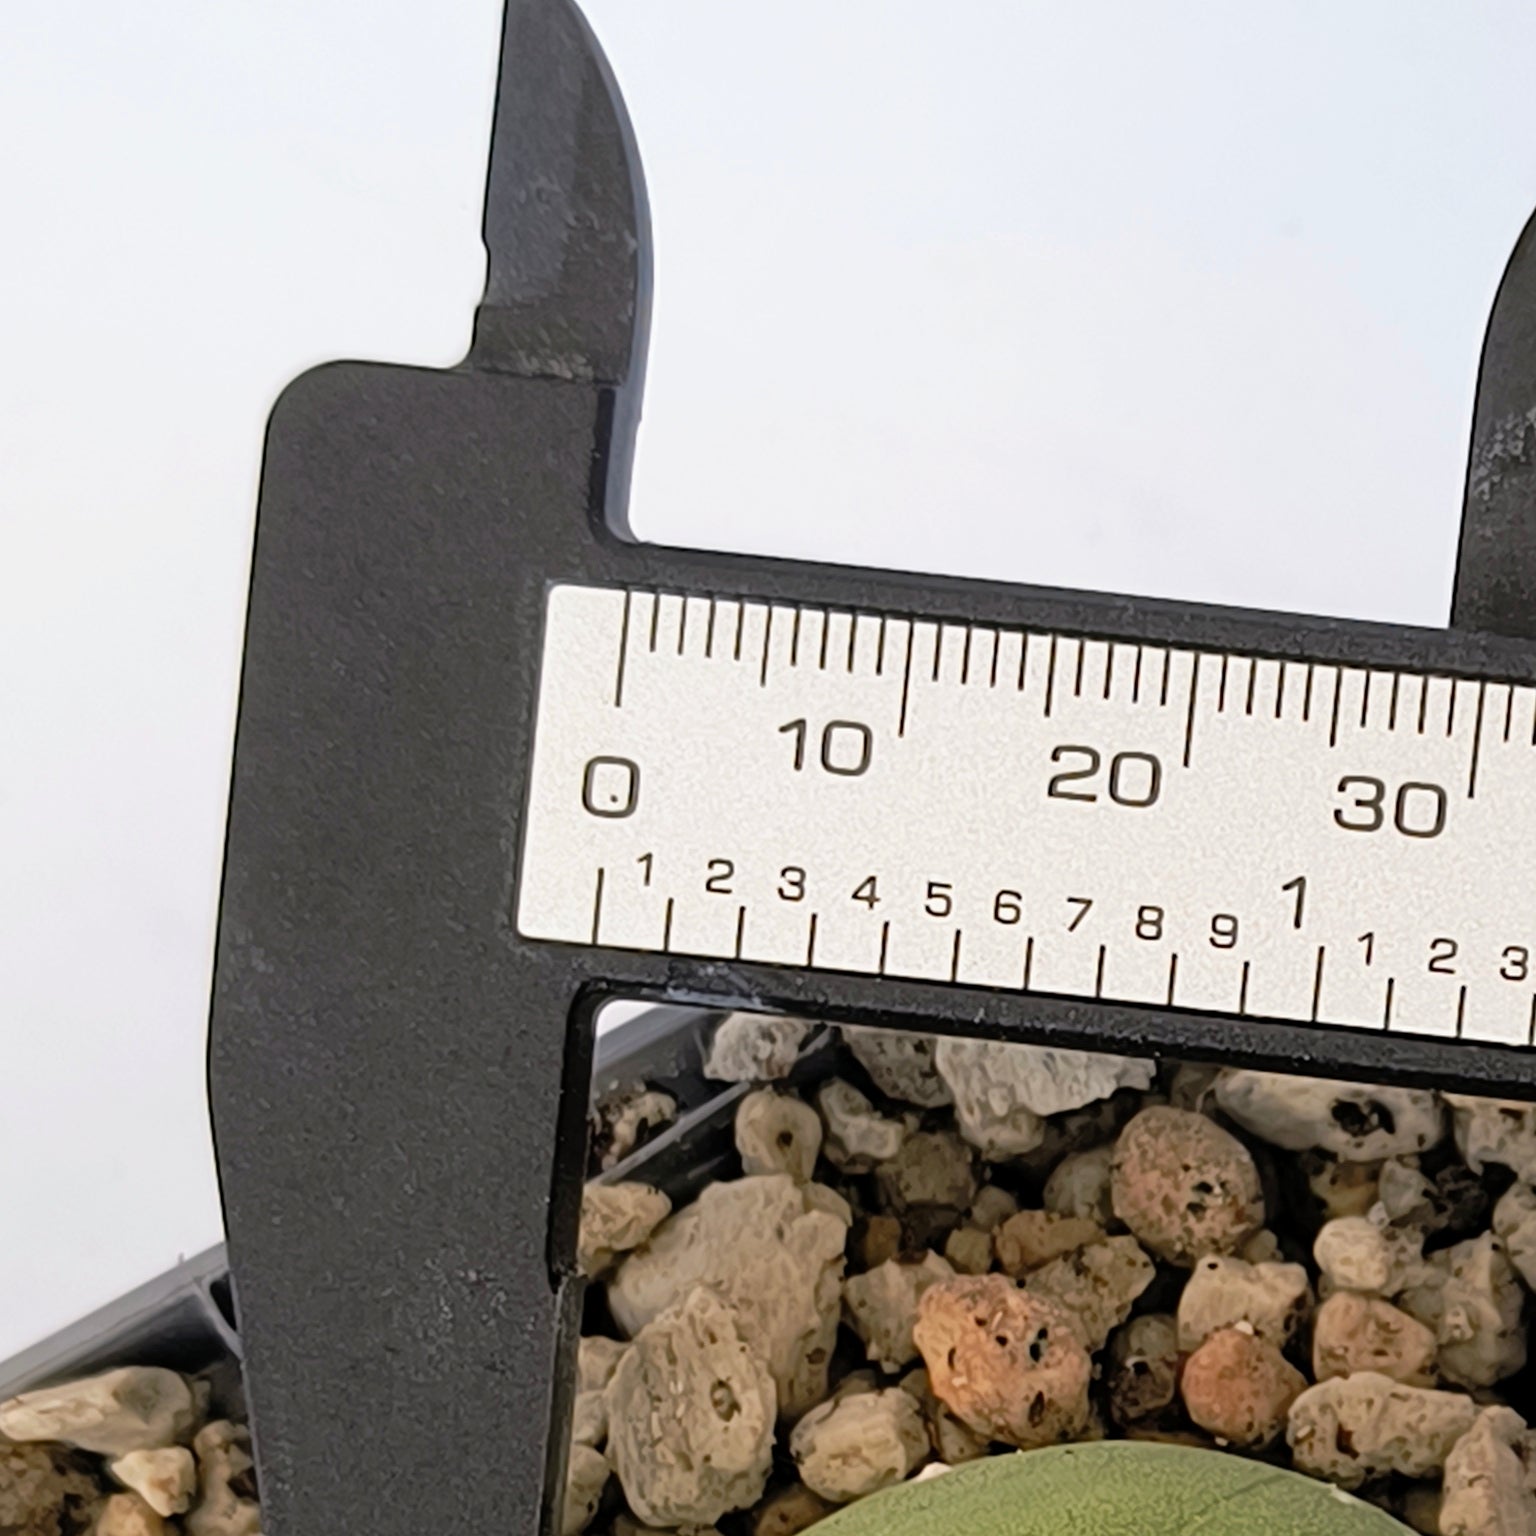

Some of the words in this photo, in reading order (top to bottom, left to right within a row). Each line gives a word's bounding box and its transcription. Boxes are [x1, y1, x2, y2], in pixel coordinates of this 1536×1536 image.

[580, 754, 641, 820] 0
[777, 717, 874, 778] 10
[1046, 744, 1163, 809] 20
[1332, 774, 1448, 840] 30
[636, 851, 655, 887] 1
[704, 857, 735, 896] 2
[776, 865, 807, 903] 3
[850, 874, 881, 911] 4
[924, 880, 953, 918] 5
[992, 888, 1024, 926] 6
[1065, 896, 1094, 933] 7
[1134, 904, 1165, 942] 8
[1208, 912, 1239, 950] 9
[1280, 875, 1307, 931] 1
[1356, 930, 1376, 967] 1
[1427, 936, 1459, 976] 2
[1498, 944, 1530, 983] 3
